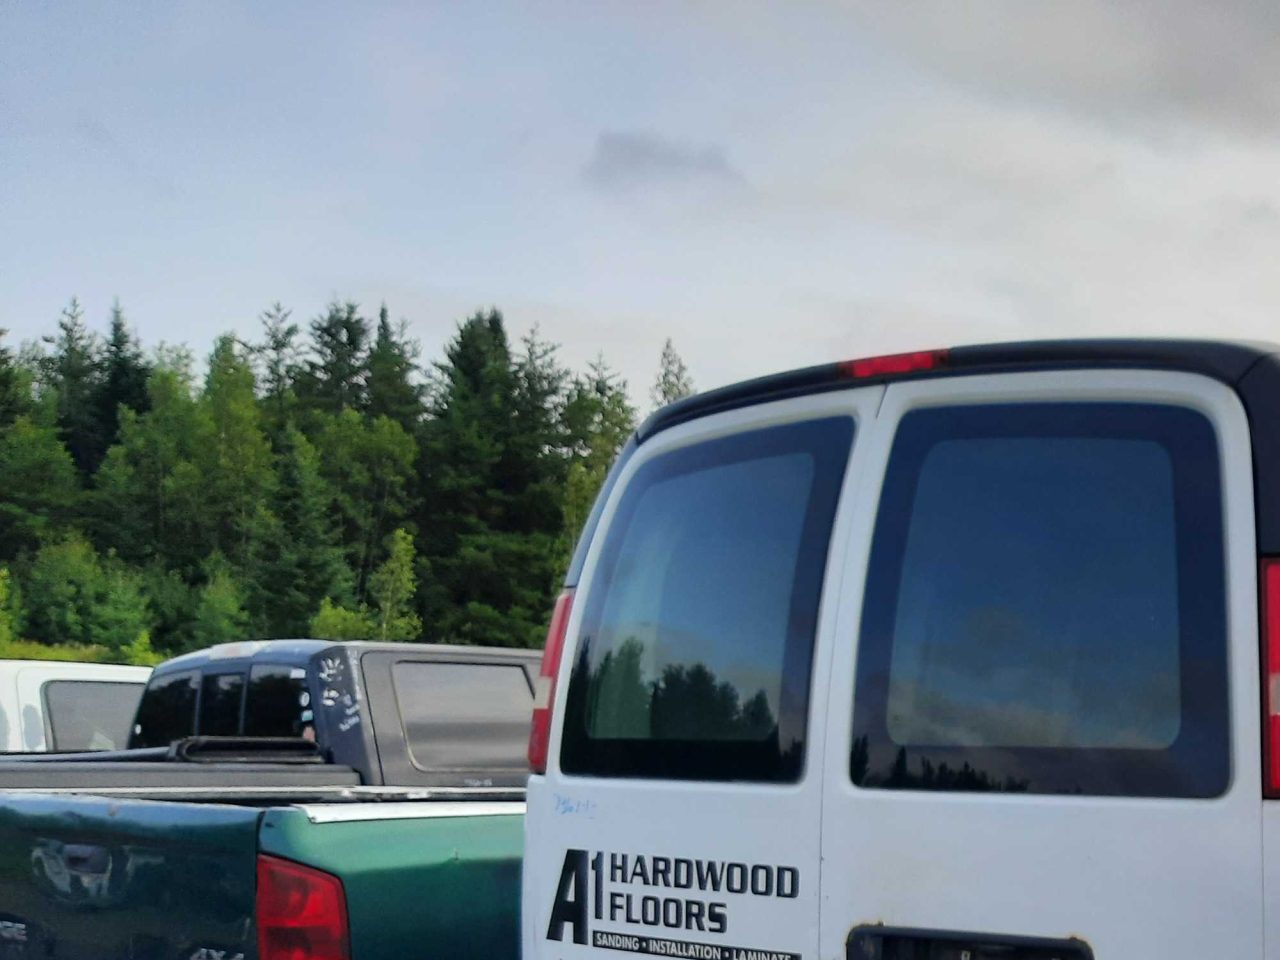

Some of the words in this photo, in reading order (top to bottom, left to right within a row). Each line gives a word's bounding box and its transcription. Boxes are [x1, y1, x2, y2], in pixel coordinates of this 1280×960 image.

[546, 848, 603, 946] A1
[610, 852, 799, 899] HARDWOOD
[610, 892, 728, 934] FLOORS
[596, 932, 640, 951] SANDING
[649, 939, 722, 960] INSTALLATION
